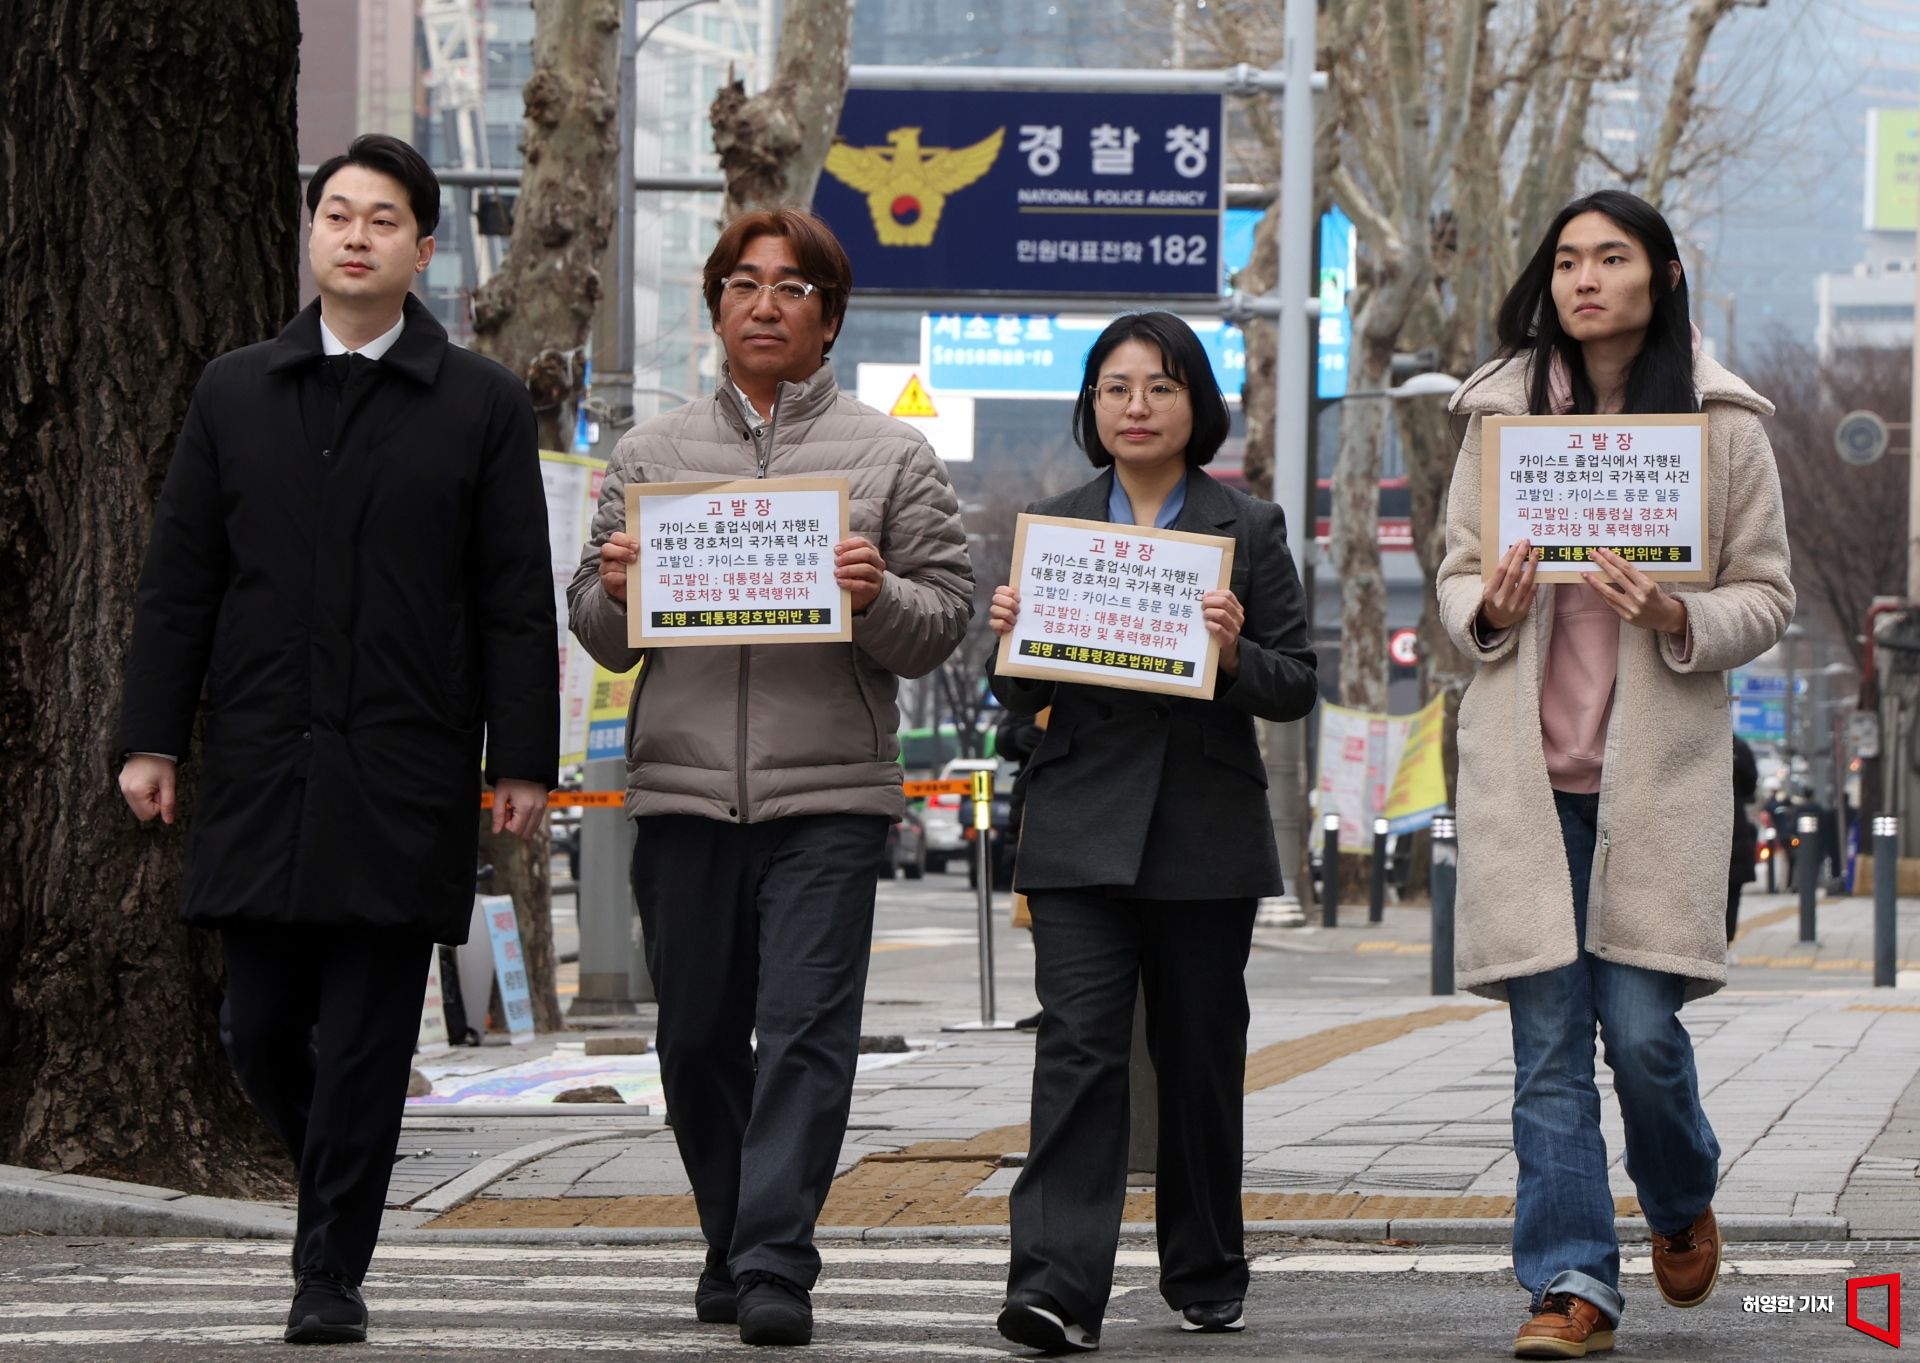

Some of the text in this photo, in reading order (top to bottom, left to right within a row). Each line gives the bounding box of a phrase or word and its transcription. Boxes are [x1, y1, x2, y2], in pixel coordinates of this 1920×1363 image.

[1017, 189, 1207, 206] NATIONAL POLICE AGENCY
[1017, 235, 1207, 265] 민원대표전화 182
[1519, 454, 1681, 468] 카이스트 졸업식에서 자행된
[1510, 470, 1690, 484] 대통령 경호처의 국가폭력 사건
[1516, 489, 1554, 502] 고발인
[1567, 489, 1618, 502] 카이스트
[1624, 489, 1649, 502] 동문
[1655, 489, 1680, 503] 일동
[1517, 508, 1569, 521] 피고발인
[1583, 507, 1633, 521] 대통령실
[1639, 507, 1678, 521] 경호처
[659, 519, 819, 534] 카이스트 졸업식에서 자행된
[1531, 523, 1670, 537] 경호처장 및 폭력행위자
[651, 534, 828, 551] 대통령 경호처의 국가폭력 사건
[656, 556, 694, 568] 고발인
[708, 554, 758, 568] 카이스트
[764, 553, 789, 567] 동문
[795, 552, 820, 566] 일동
[1668, 547, 1681, 561] 등
[1041, 552, 1199, 585] 카이스트 졸업식에서 자행된
[659, 573, 709, 586] 피고발인
[723, 572, 773, 585] 대통령실
[779, 571, 817, 584] 경호처
[1031, 567, 1205, 602] 대통령 경호처의 국가폭력 사건
[672, 587, 810, 602] 경호처장 및 폭력행위자
[1033, 585, 1069, 601] 고발인
[1082, 591, 1131, 608] 카이스트
[1137, 598, 1162, 613] 동문
[1168, 603, 1193, 618] 일동
[661, 612, 687, 625] 죄명
[700, 610, 803, 625] 대통령경호법위반
[808, 610, 821, 624] 등
[1033, 605, 1081, 621] 피고발인
[1094, 611, 1144, 630] 대통령실
[1150, 619, 1188, 636] 경호처
[1043, 620, 1178, 650] 경호처장 및 폭력행위자
[1028, 642, 1054, 656] 죄명
[1065, 646, 1168, 673] 대통령경호법위반
[1171, 661, 1185, 675] 등
